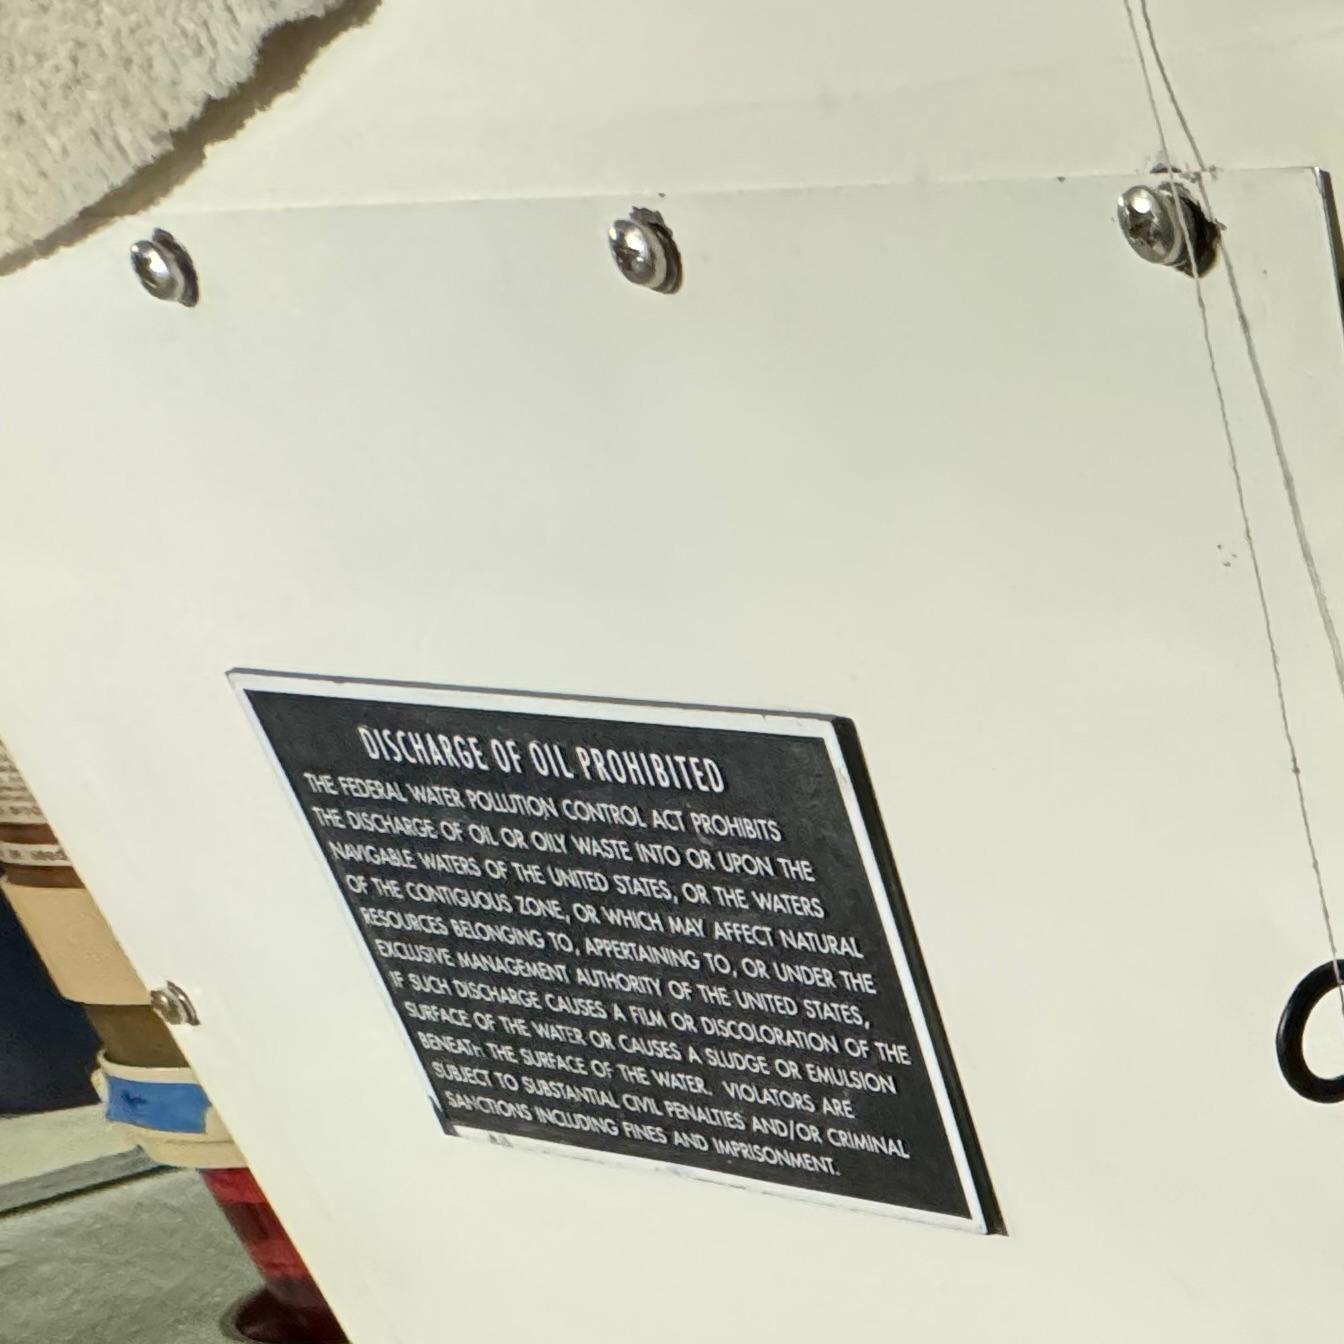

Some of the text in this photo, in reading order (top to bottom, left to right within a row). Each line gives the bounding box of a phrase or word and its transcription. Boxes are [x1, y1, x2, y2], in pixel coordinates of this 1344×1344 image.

[357, 725, 724, 793] DISCHARGE OF OIL PROHIBITED
[303, 772, 782, 842] THE FEDERAL WATER POLLUTION CONTROL ACT PROHIBITS
[311, 806, 816, 882] THE DISCHARGE OF OIL OR OILY WASTE INTO OR UPON THE
[328, 841, 825, 919] NAVIGABLE WATERS OF THE UNITED STATES, OR THE WATERS
[345, 874, 864, 959] OF THE CONTIGUOUS ZONE, OR WHICH MAY AFFECT NATURAL
[359, 906, 877, 994] RESOURCES BELONGING TO, APPERTAINING TO, OR UNDER THE
[374, 938, 870, 1028] EXCLUSIVE MANAGEMENT AUTHORITY OF THE UNITED STATES,
[389, 970, 911, 1066] IF SUCH DISCHARGE CAUSES A FILM OR DISCOLORATION OF THE
[404, 1001, 897, 1094] SURFACE OF THE WATER OR CAUSES A SLUDGE OR EMULSION
[431, 1061, 910, 1159] SUBJECT TO SUBSTANTIAL CIVIL PENALTIES AND/OR CRIMINAL
[485, 1042, 519, 1064] THE
[519, 1048, 588, 1075] SURFACE
[590, 1059, 612, 1078] OF
[616, 1064, 651, 1086] THE
[650, 1069, 713, 1096] WATER.
[722, 1081, 816, 1113] VIOLATORS
[822, 1097, 855, 1119] ARE
[444, 1090, 840, 1175] SANCTIONS INCLUDING FINES AND IMPRISONMENT.
